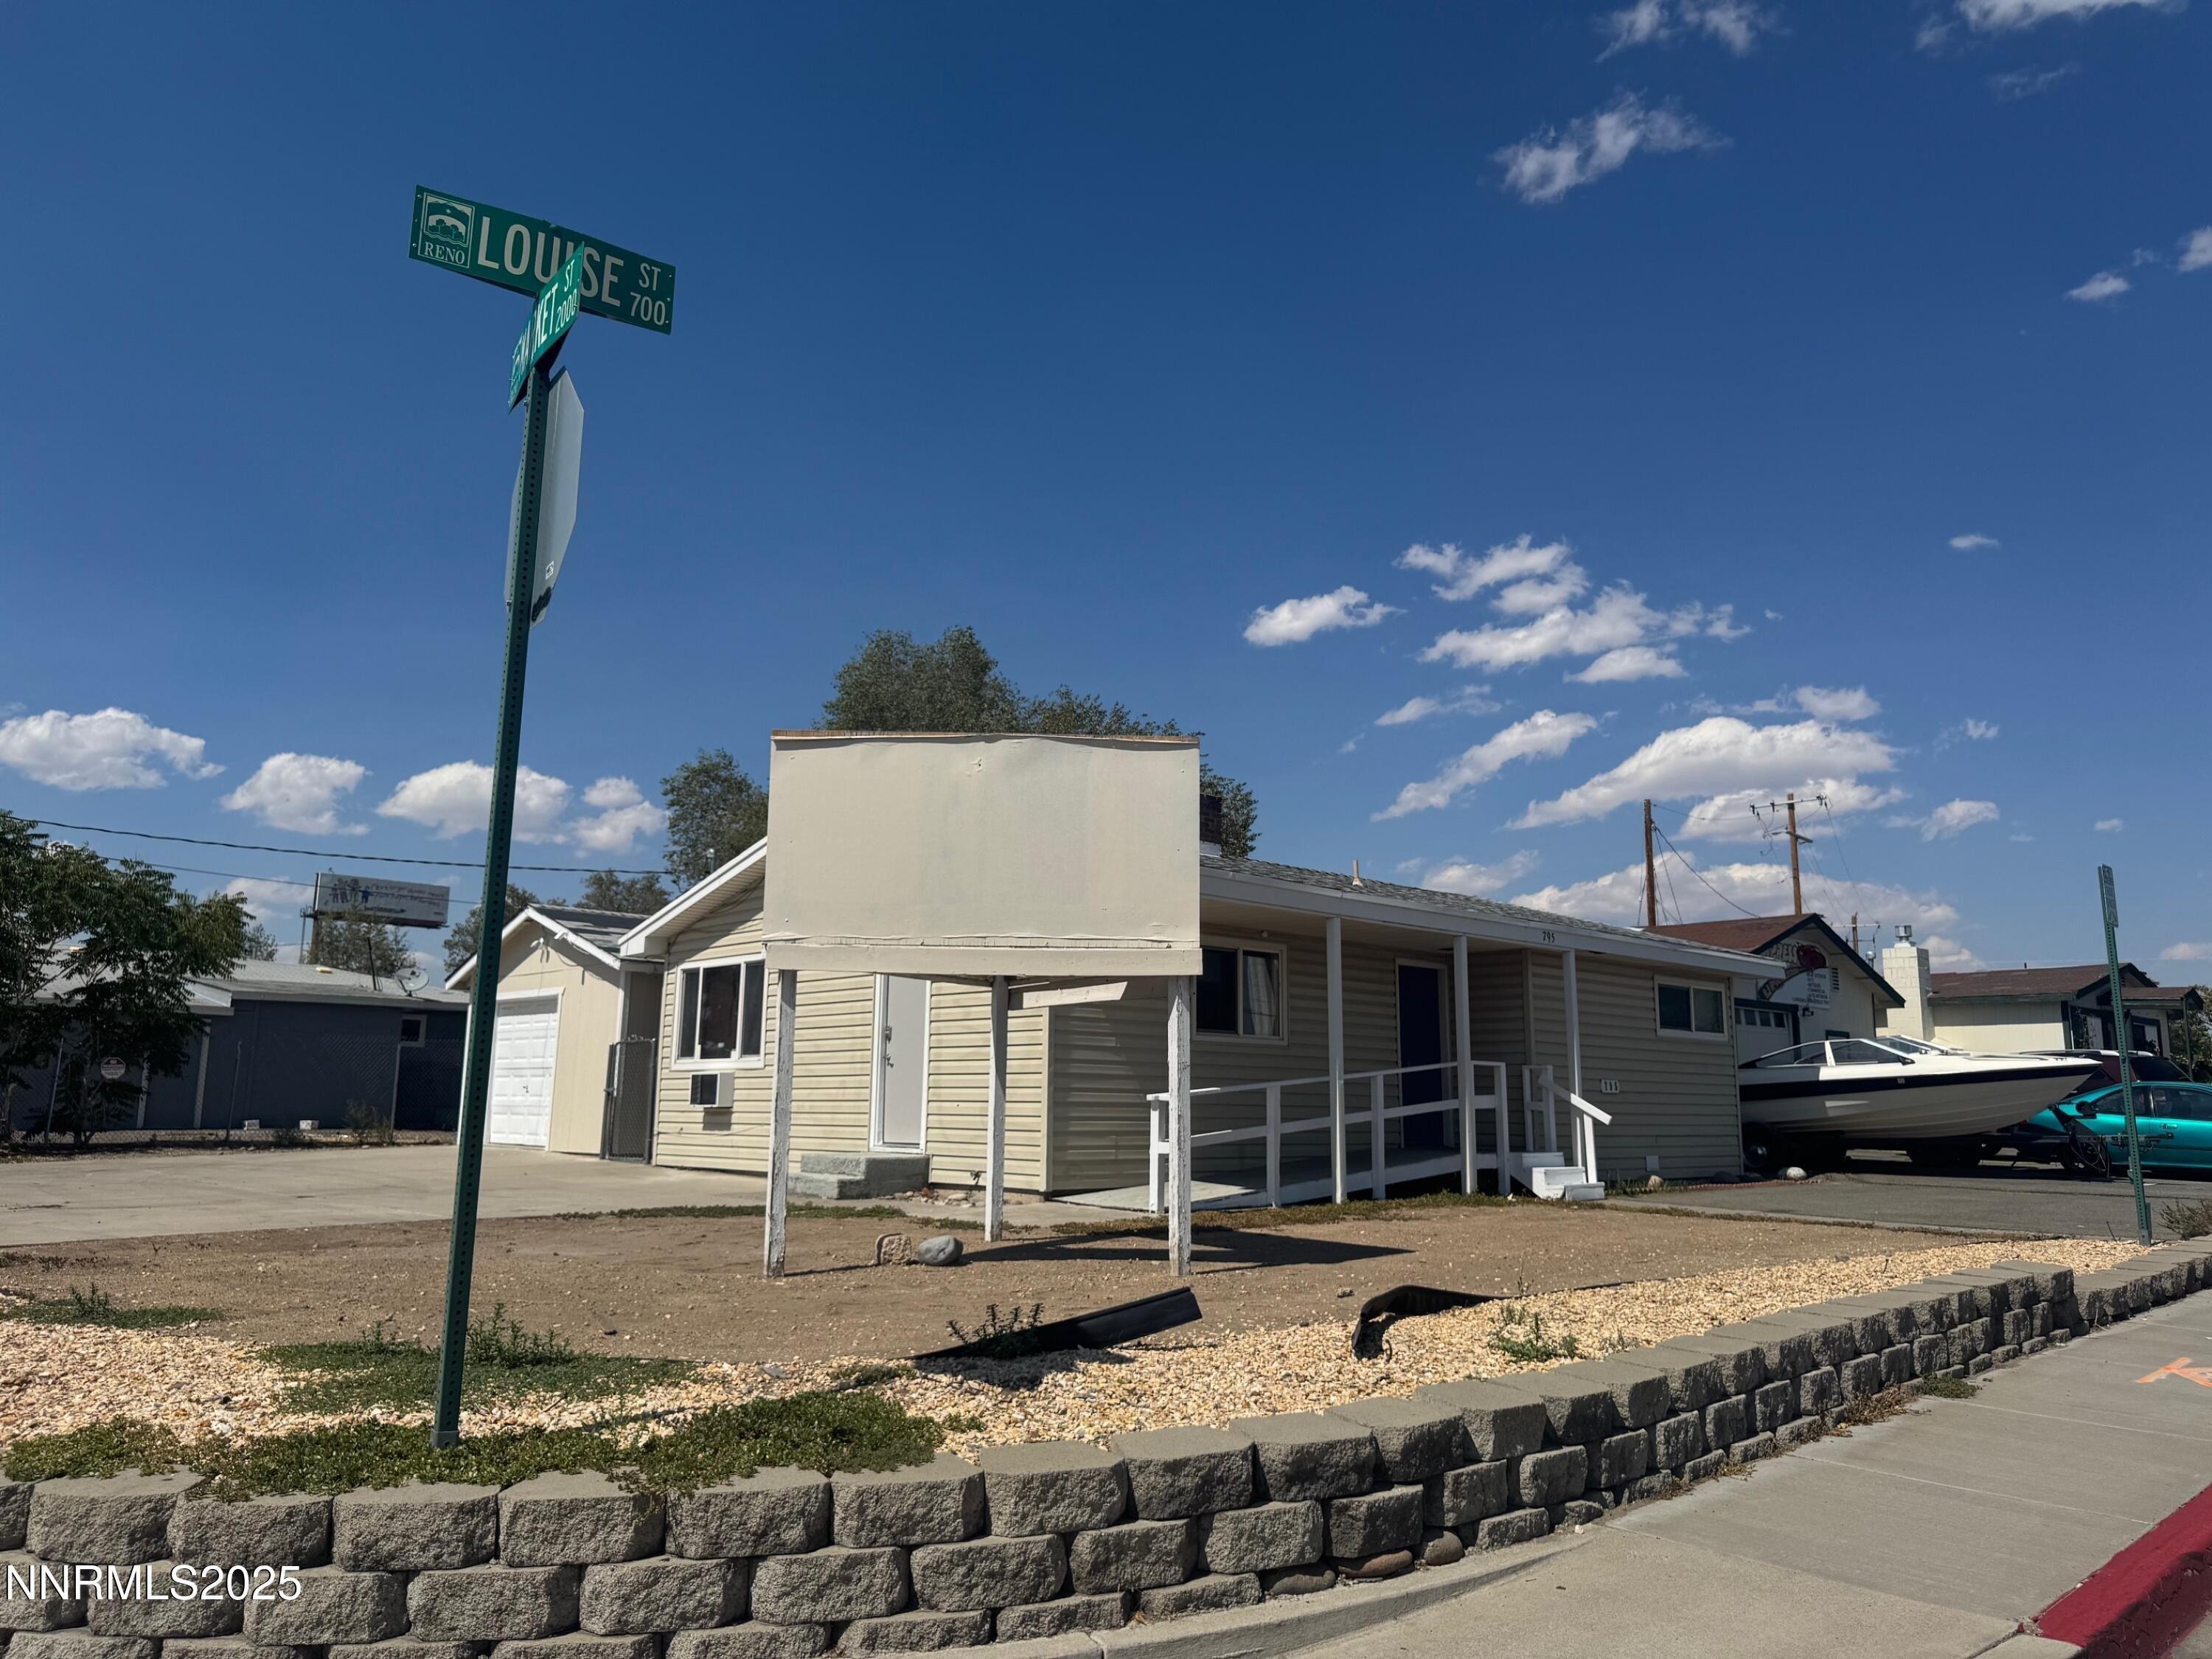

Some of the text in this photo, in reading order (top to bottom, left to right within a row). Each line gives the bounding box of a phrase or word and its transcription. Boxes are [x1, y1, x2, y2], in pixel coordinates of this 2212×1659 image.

[424, 241, 465, 265] RENO
[563, 259, 575, 292] ST
[639, 262, 661, 291] ST
[554, 288, 578, 333] 2000
[629, 291, 666, 326] 700
[1542, 931, 1556, 944] 795
